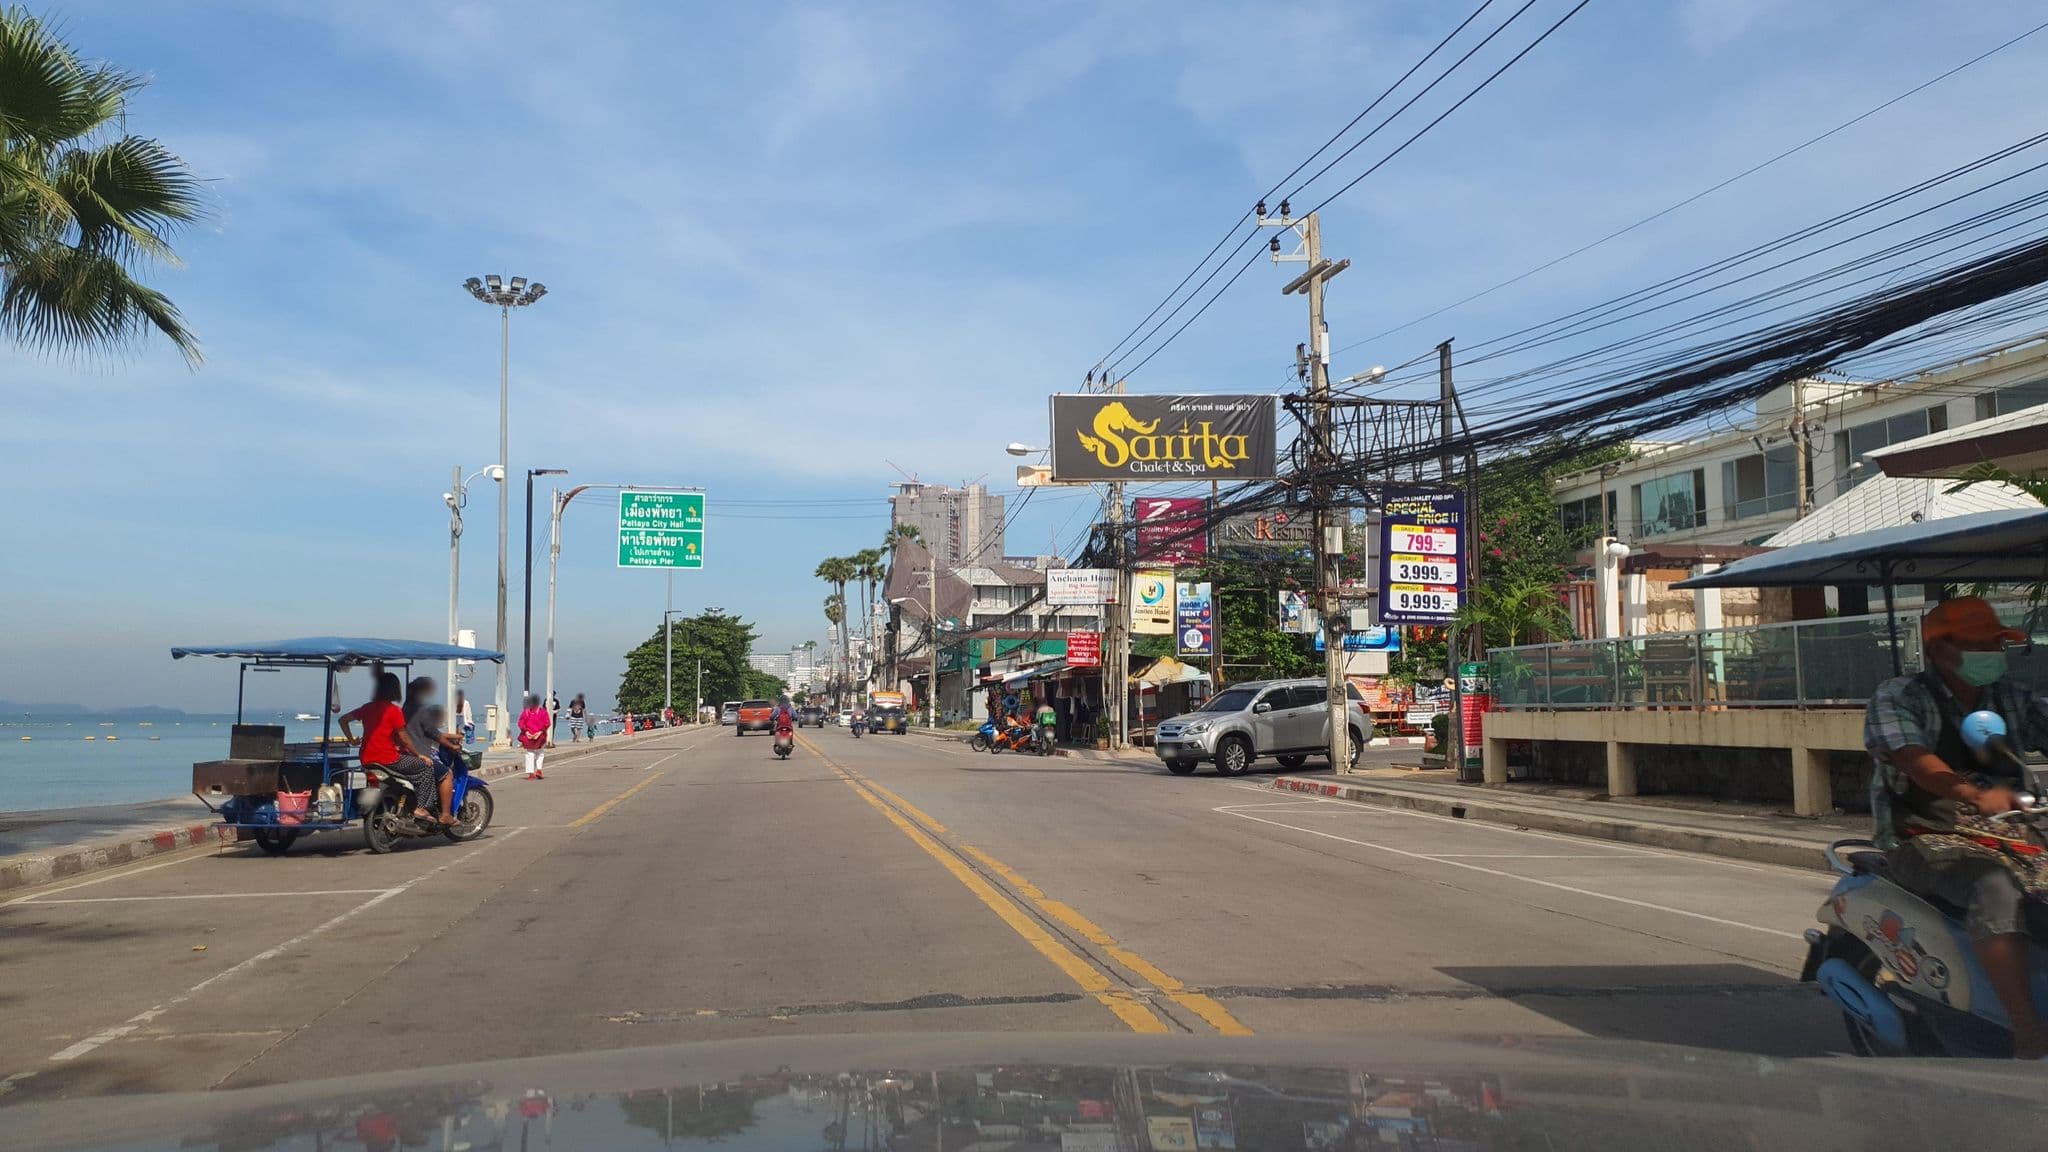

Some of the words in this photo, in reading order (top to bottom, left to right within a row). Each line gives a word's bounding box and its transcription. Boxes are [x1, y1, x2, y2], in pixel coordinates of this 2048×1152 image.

[1077, 402, 1250, 468] Sarita
[1129, 461, 1172, 473] Chalet
[1173, 462, 1185, 473] &
[1185, 461, 1206, 475] Spa
[625, 503, 682, 519] เมืองพัทยา
[1385, 501, 1436, 515] SPECIAL
[621, 519, 650, 529] Pattaya
[652, 520, 667, 529] City
[670, 520, 684, 528] Hall
[1417, 512, 1449, 525] PRICE
[621, 531, 683, 547] ท่าเรือพัทยา
[629, 557, 657, 566] Pattaya
[659, 557, 674, 565] Pier
[1050, 574, 1088, 583] Anchana
